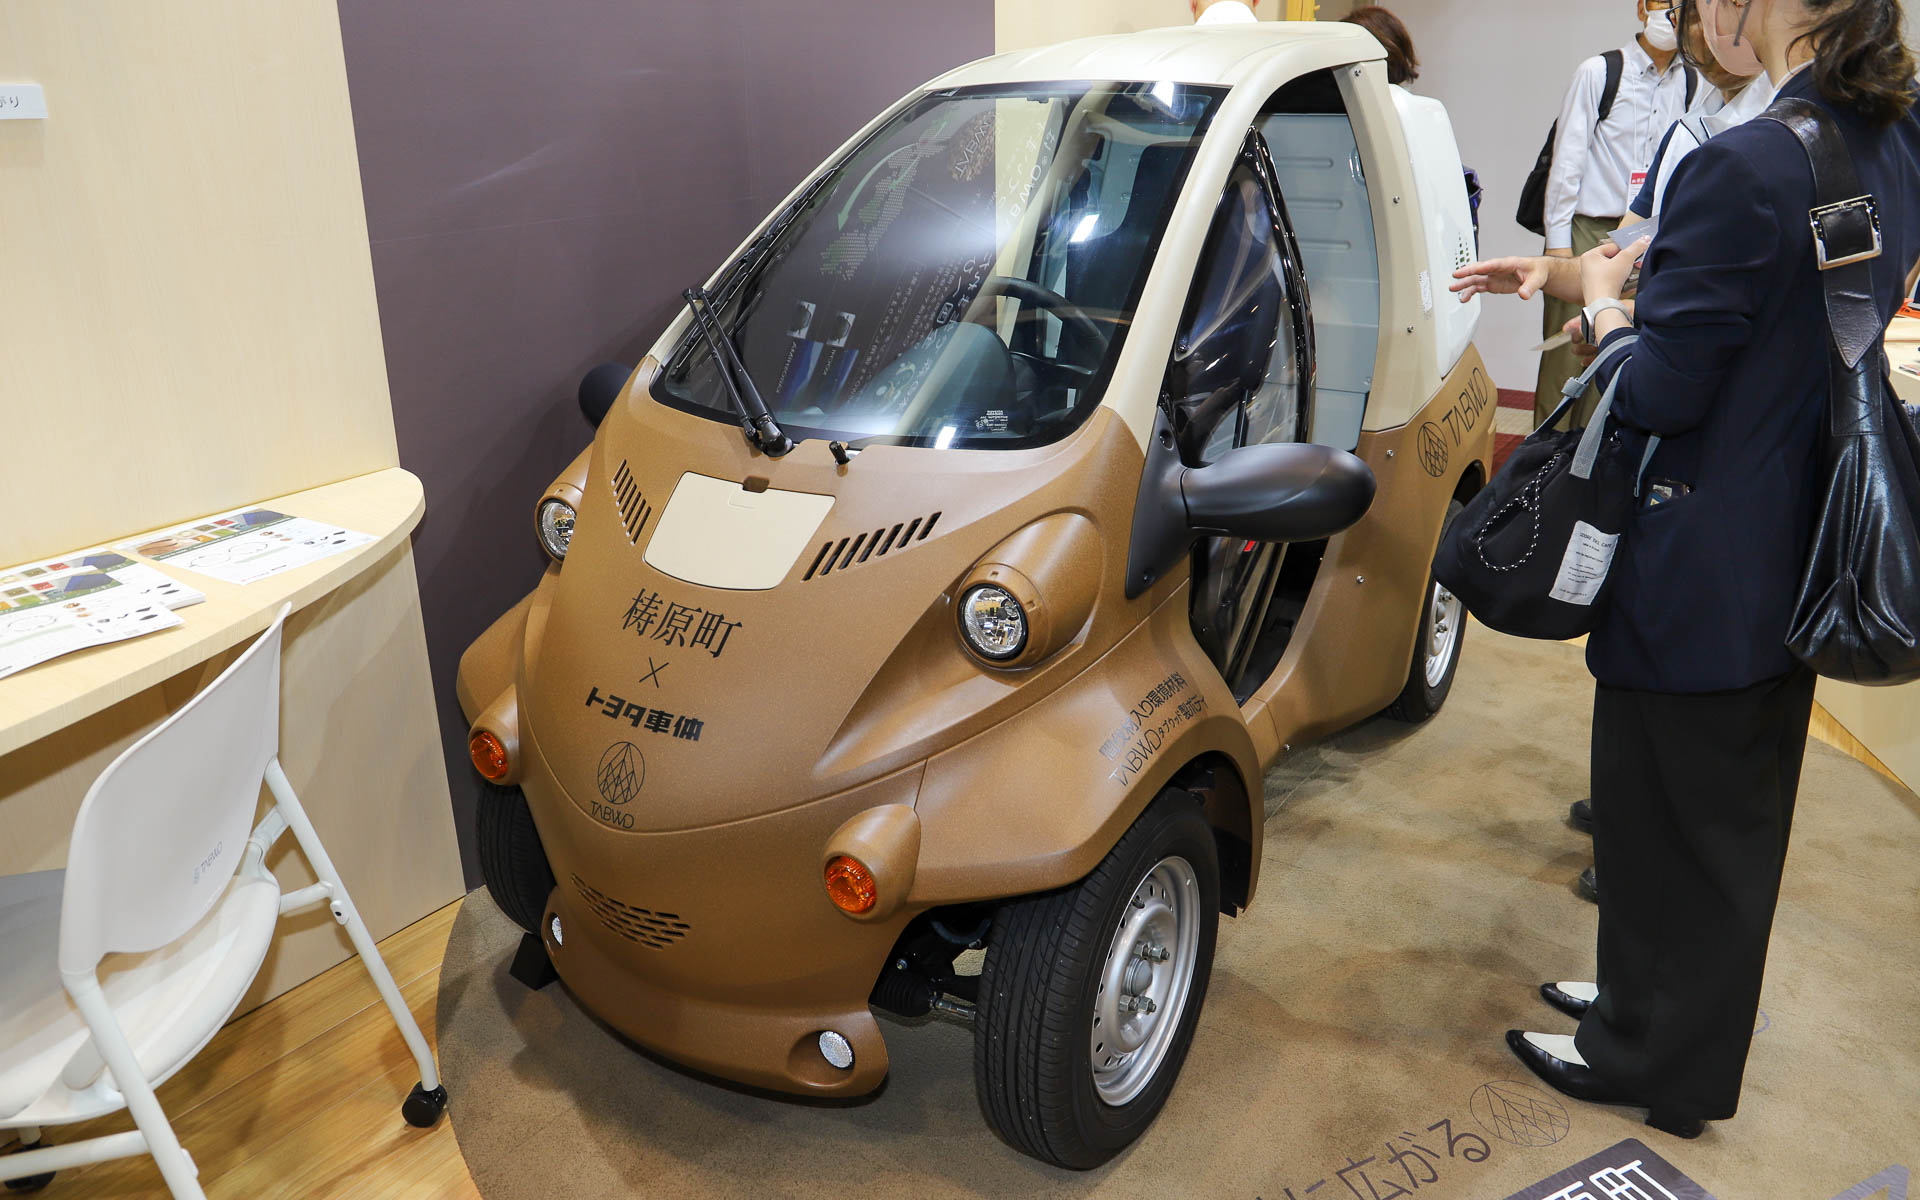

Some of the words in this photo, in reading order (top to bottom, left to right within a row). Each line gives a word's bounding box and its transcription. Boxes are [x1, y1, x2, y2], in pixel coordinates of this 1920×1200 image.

[1442, 367, 1488, 447] TABWD
[622, 588, 742, 658] 梼原町
[585, 687, 704, 741] トヨタ車体
[590, 800, 634, 829] TABWD
